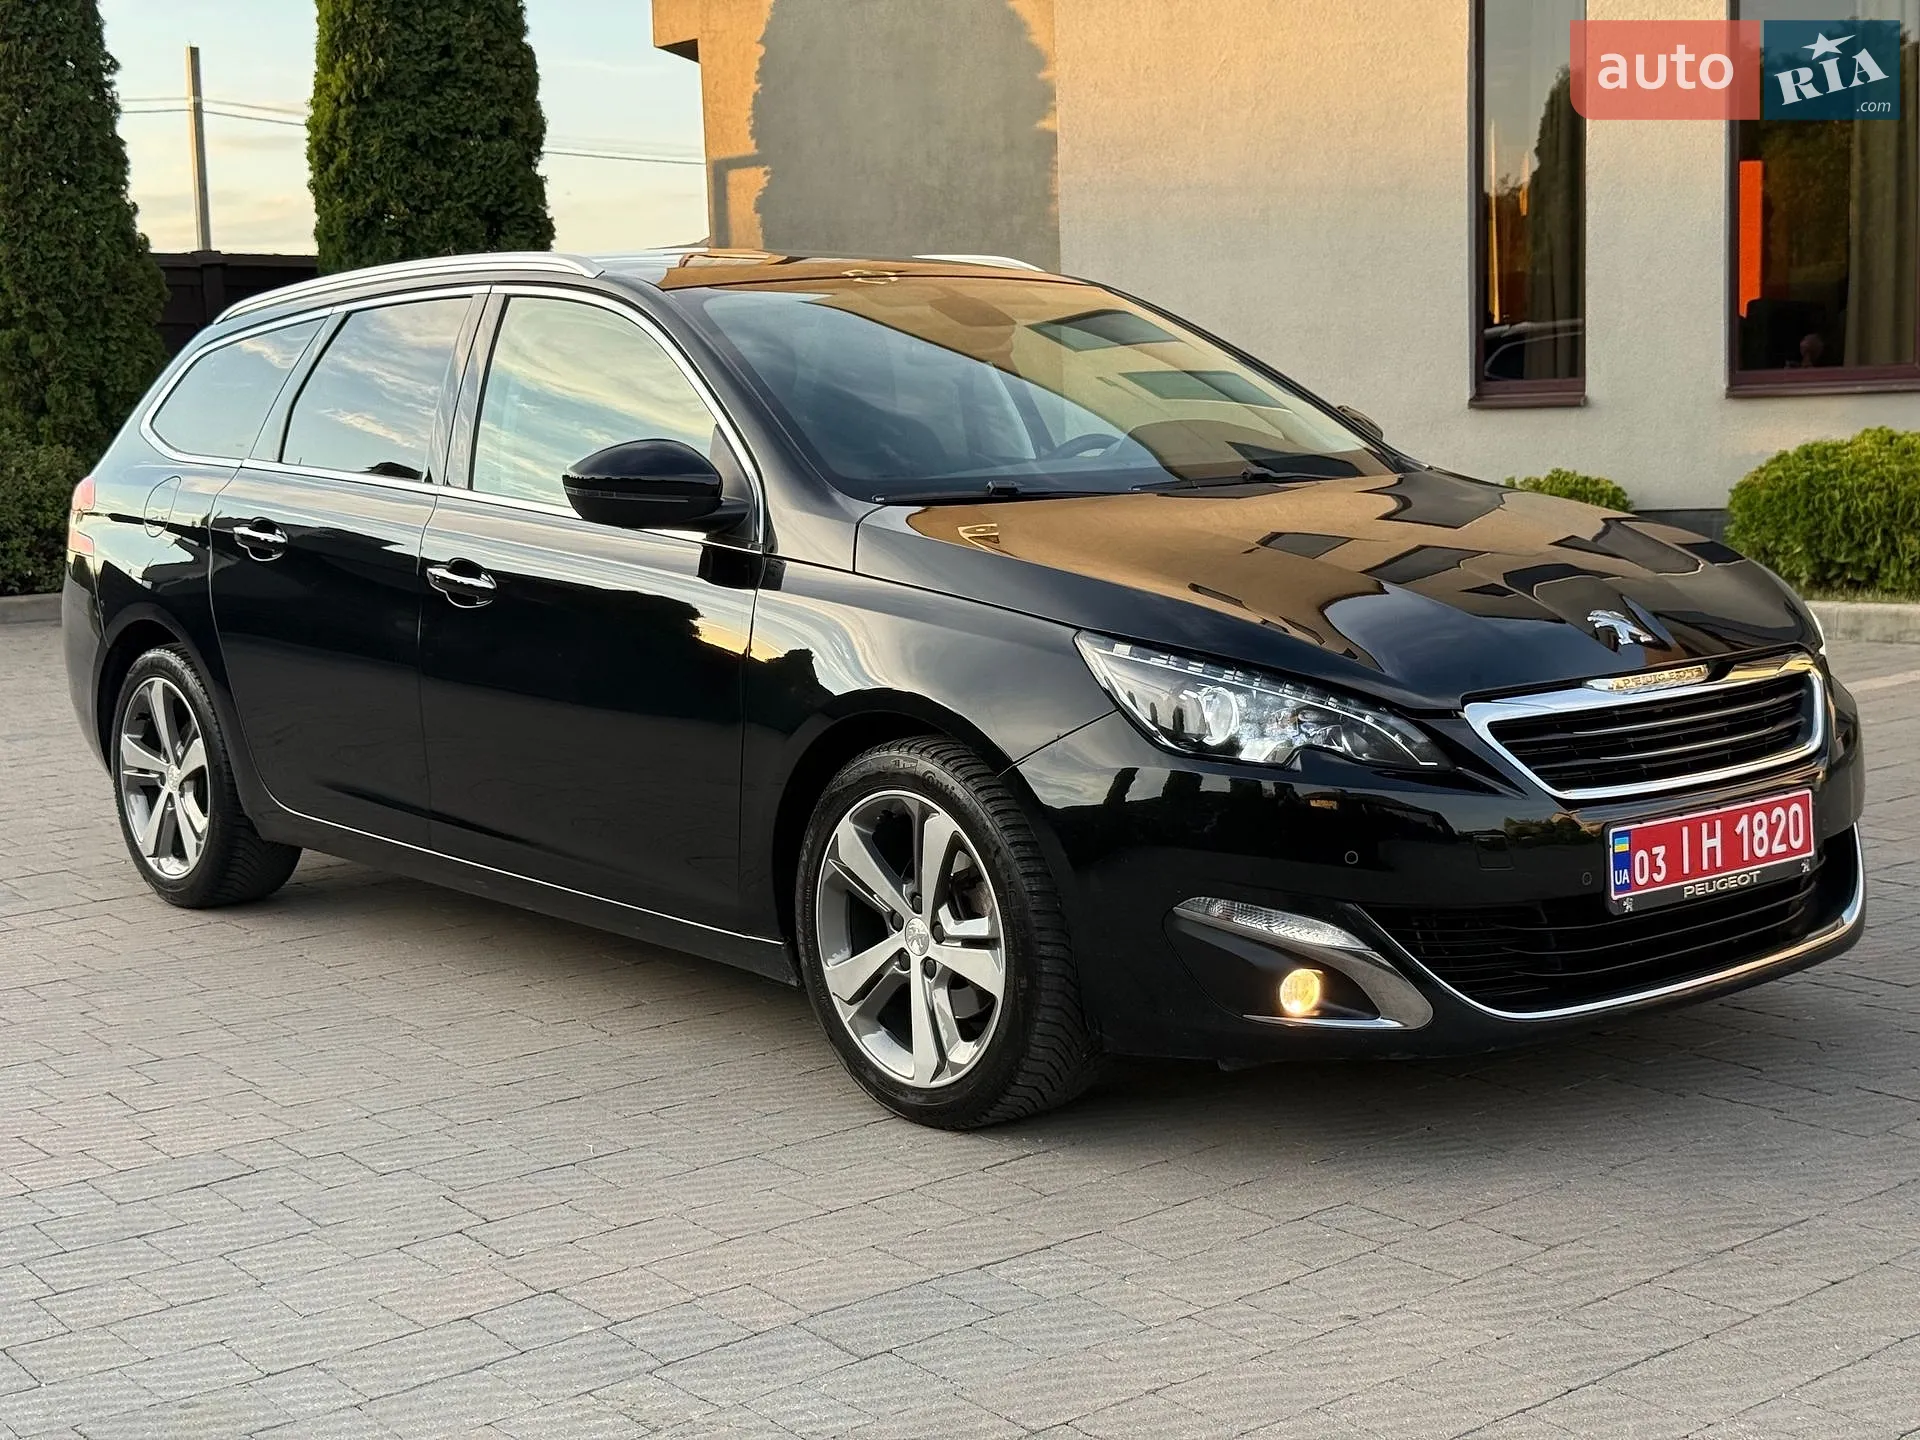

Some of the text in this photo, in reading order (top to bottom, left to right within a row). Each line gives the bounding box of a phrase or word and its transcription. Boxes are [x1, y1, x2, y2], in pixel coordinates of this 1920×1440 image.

[1634, 845, 1667, 886] 03
[1734, 803, 1804, 862] 1820
[1615, 868, 1630, 886] UA
[1683, 870, 1761, 899] PEUGEOT
